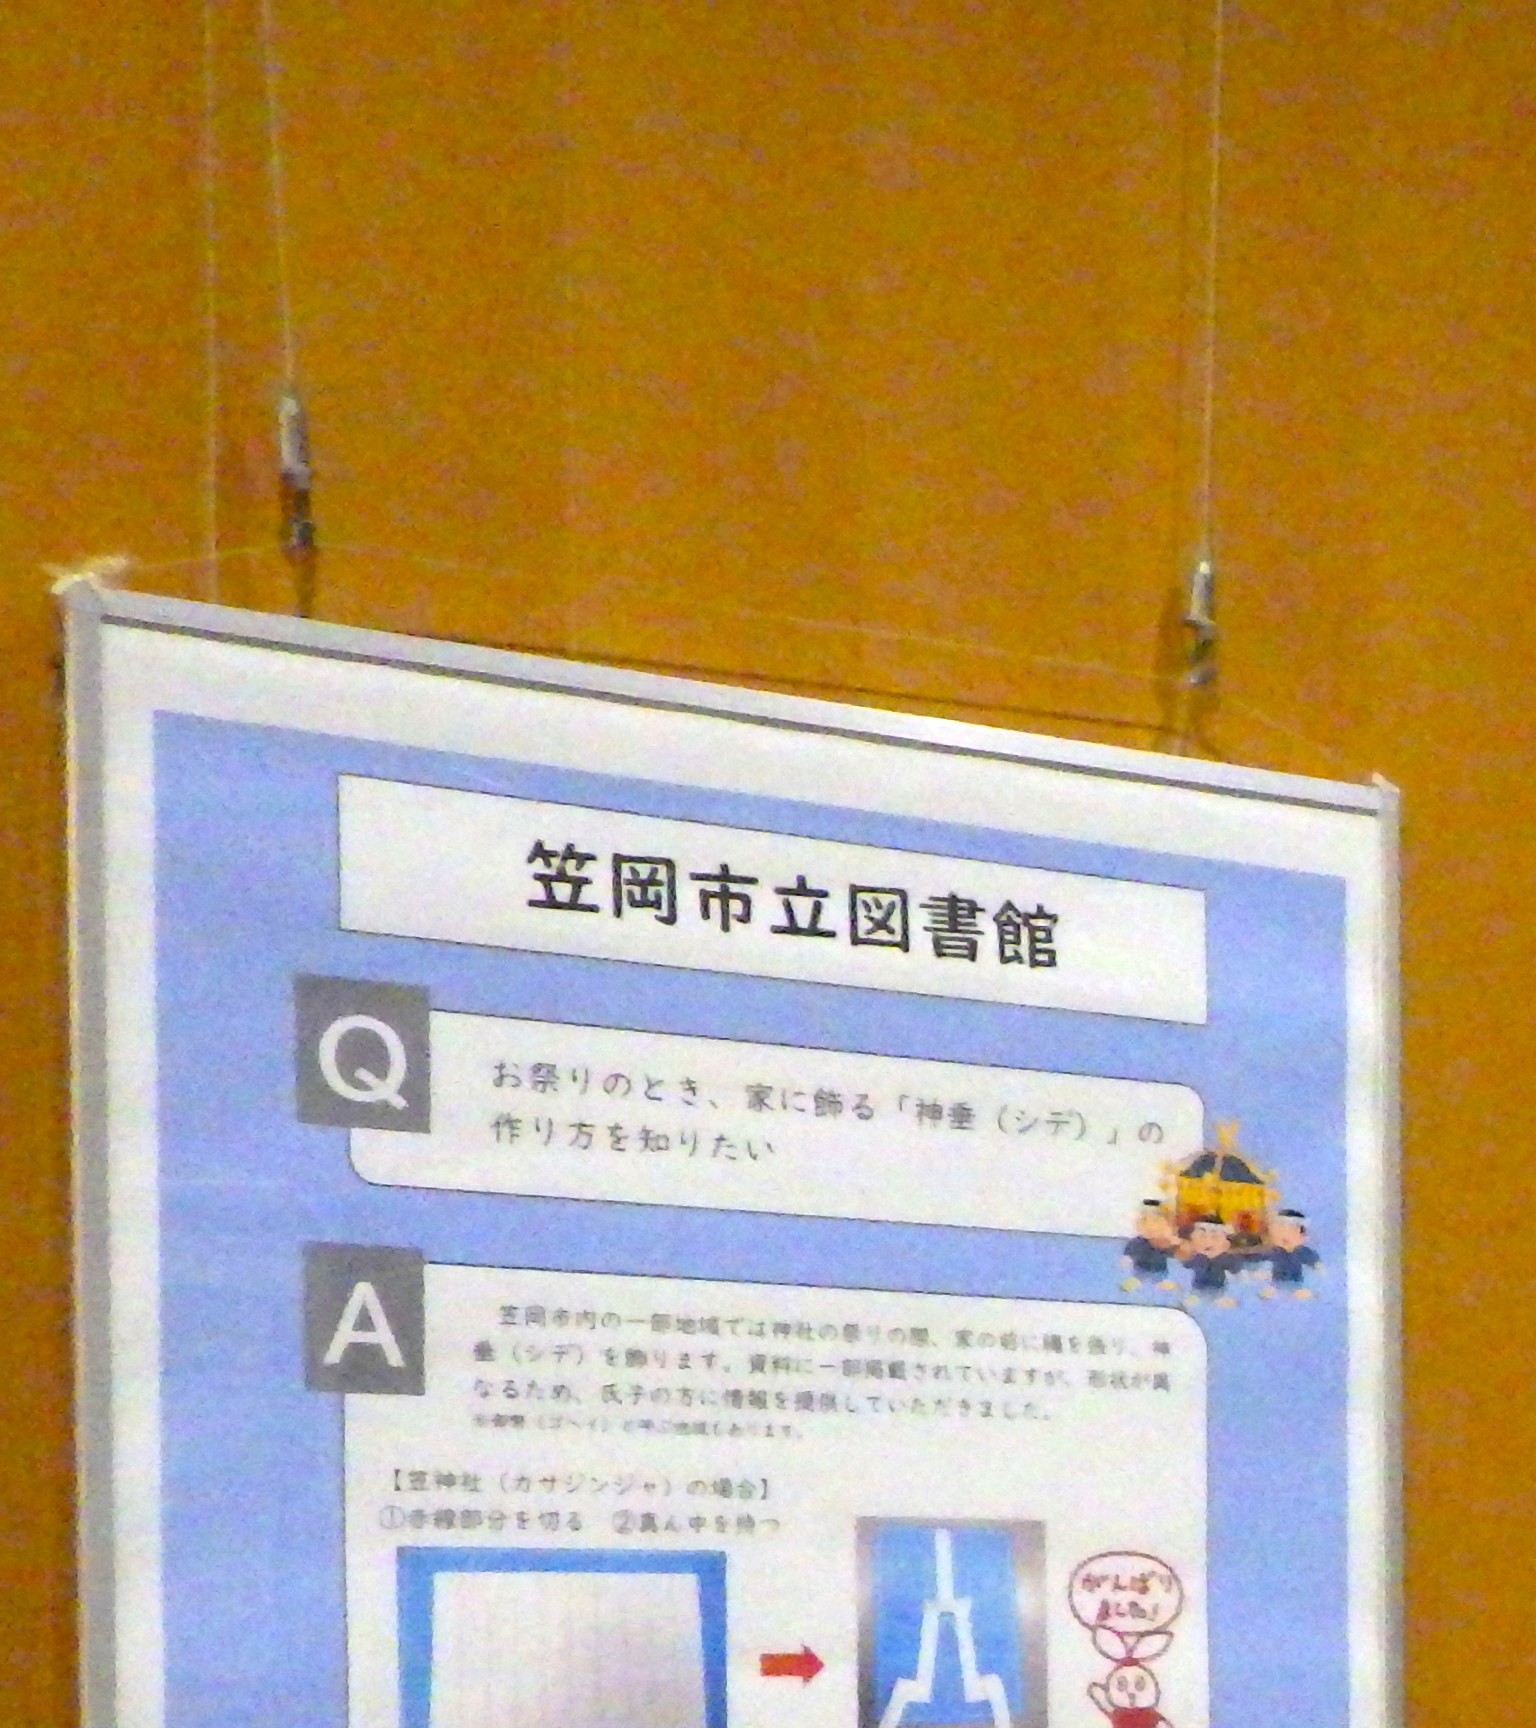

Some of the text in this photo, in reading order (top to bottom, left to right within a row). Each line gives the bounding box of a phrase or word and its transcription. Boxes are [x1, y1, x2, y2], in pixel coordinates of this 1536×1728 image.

[526, 839, 1060, 971] 笠岡市立図書館
[318, 1014, 409, 1110] Q
[489, 1112, 777, 1164] 作り方を知りたい
[323, 1281, 405, 1369] A
